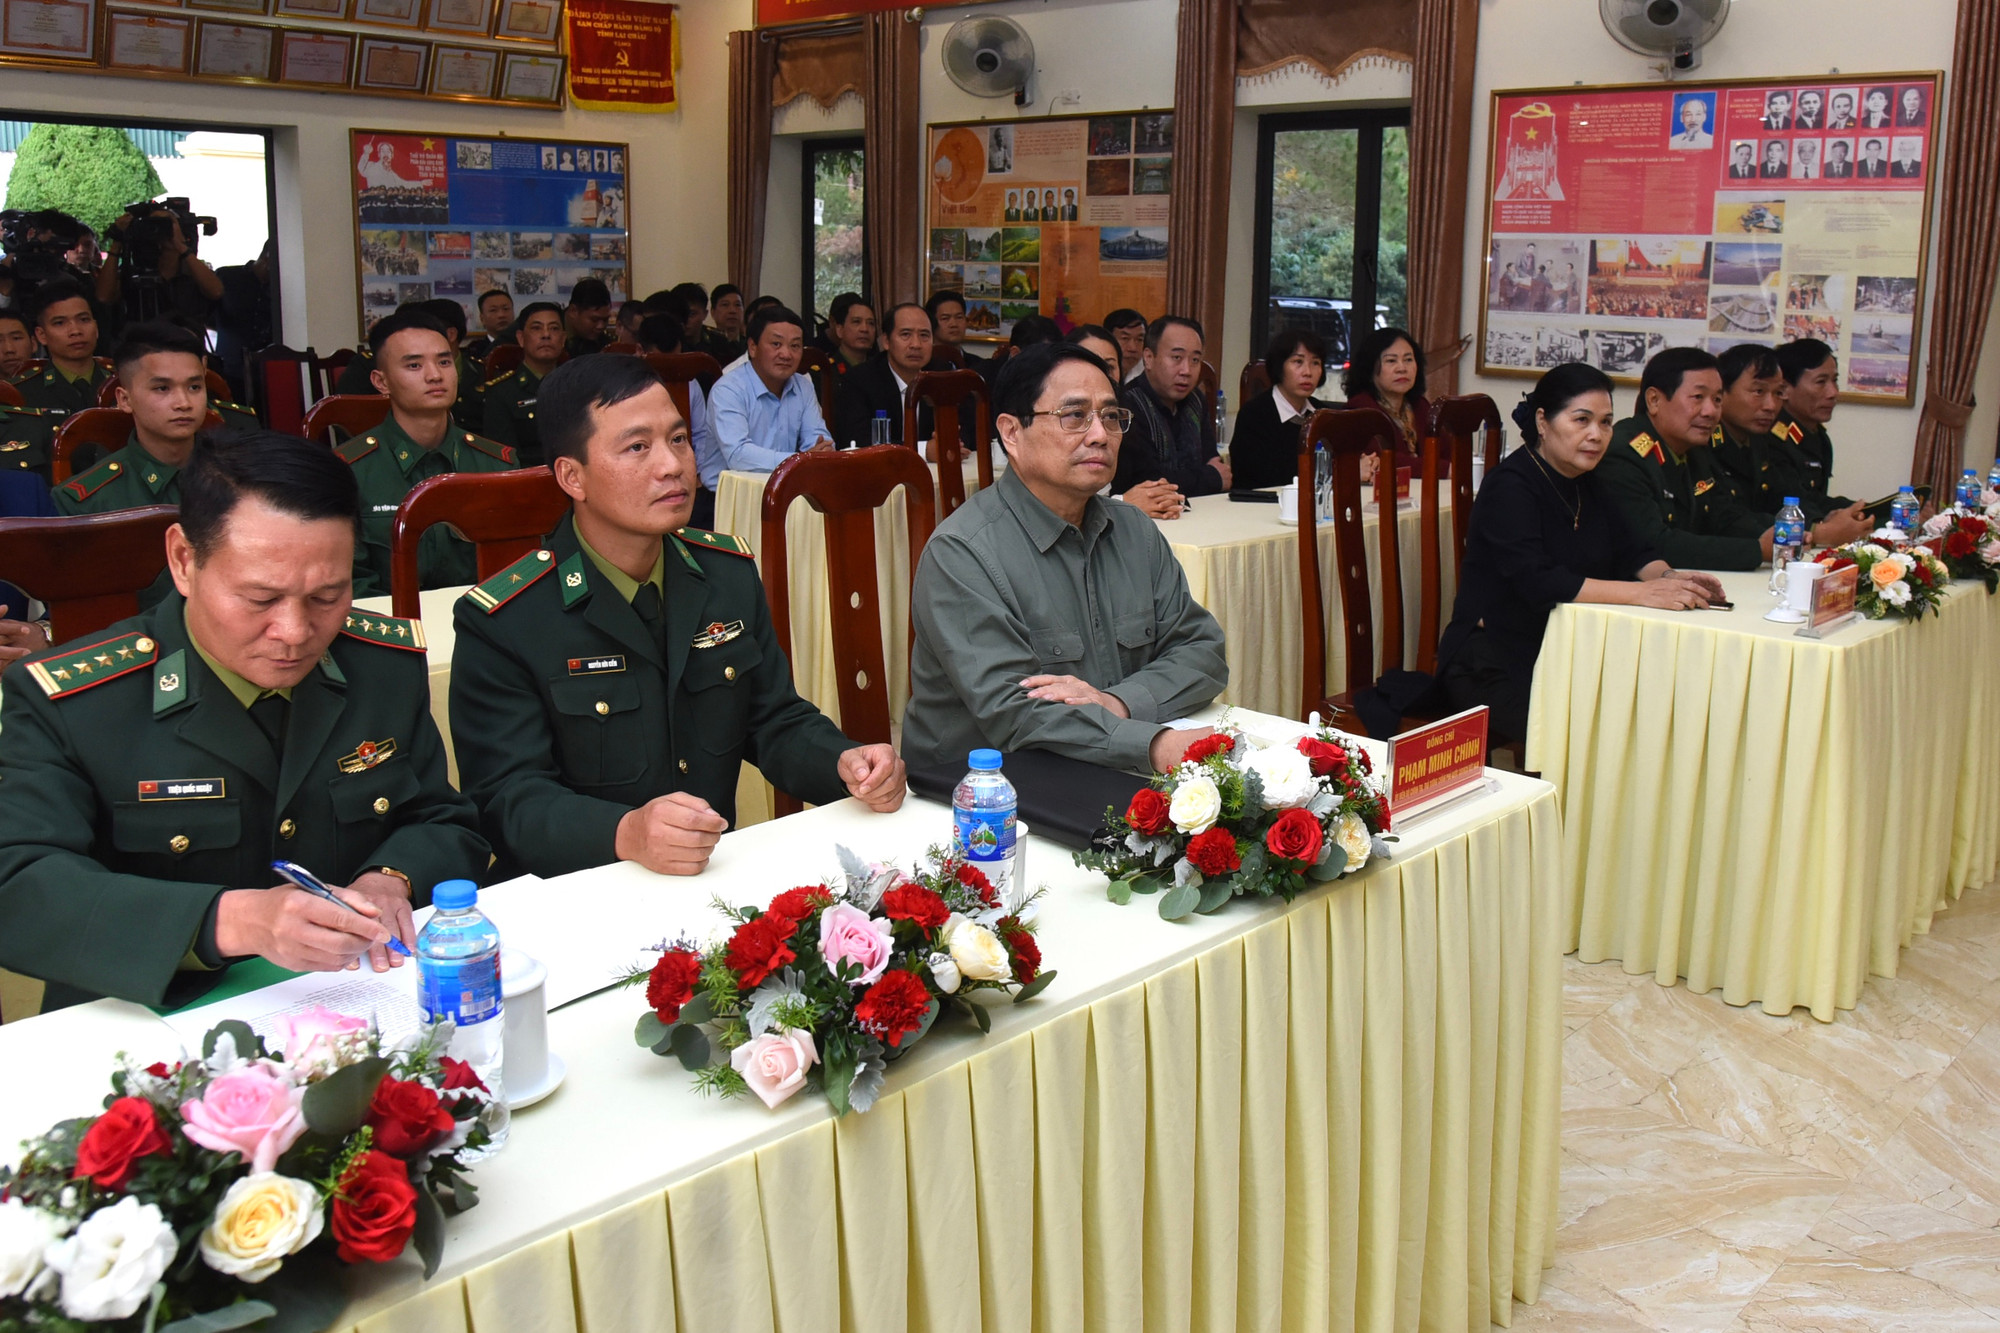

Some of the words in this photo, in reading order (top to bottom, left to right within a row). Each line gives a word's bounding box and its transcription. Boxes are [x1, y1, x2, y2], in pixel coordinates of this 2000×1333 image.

[1445, 729, 1455, 743] CHÍ
[1399, 758, 1426, 785] PHẠM
[1429, 748, 1453, 774] MINH
[1455, 738, 1480, 764] CHÍNH
